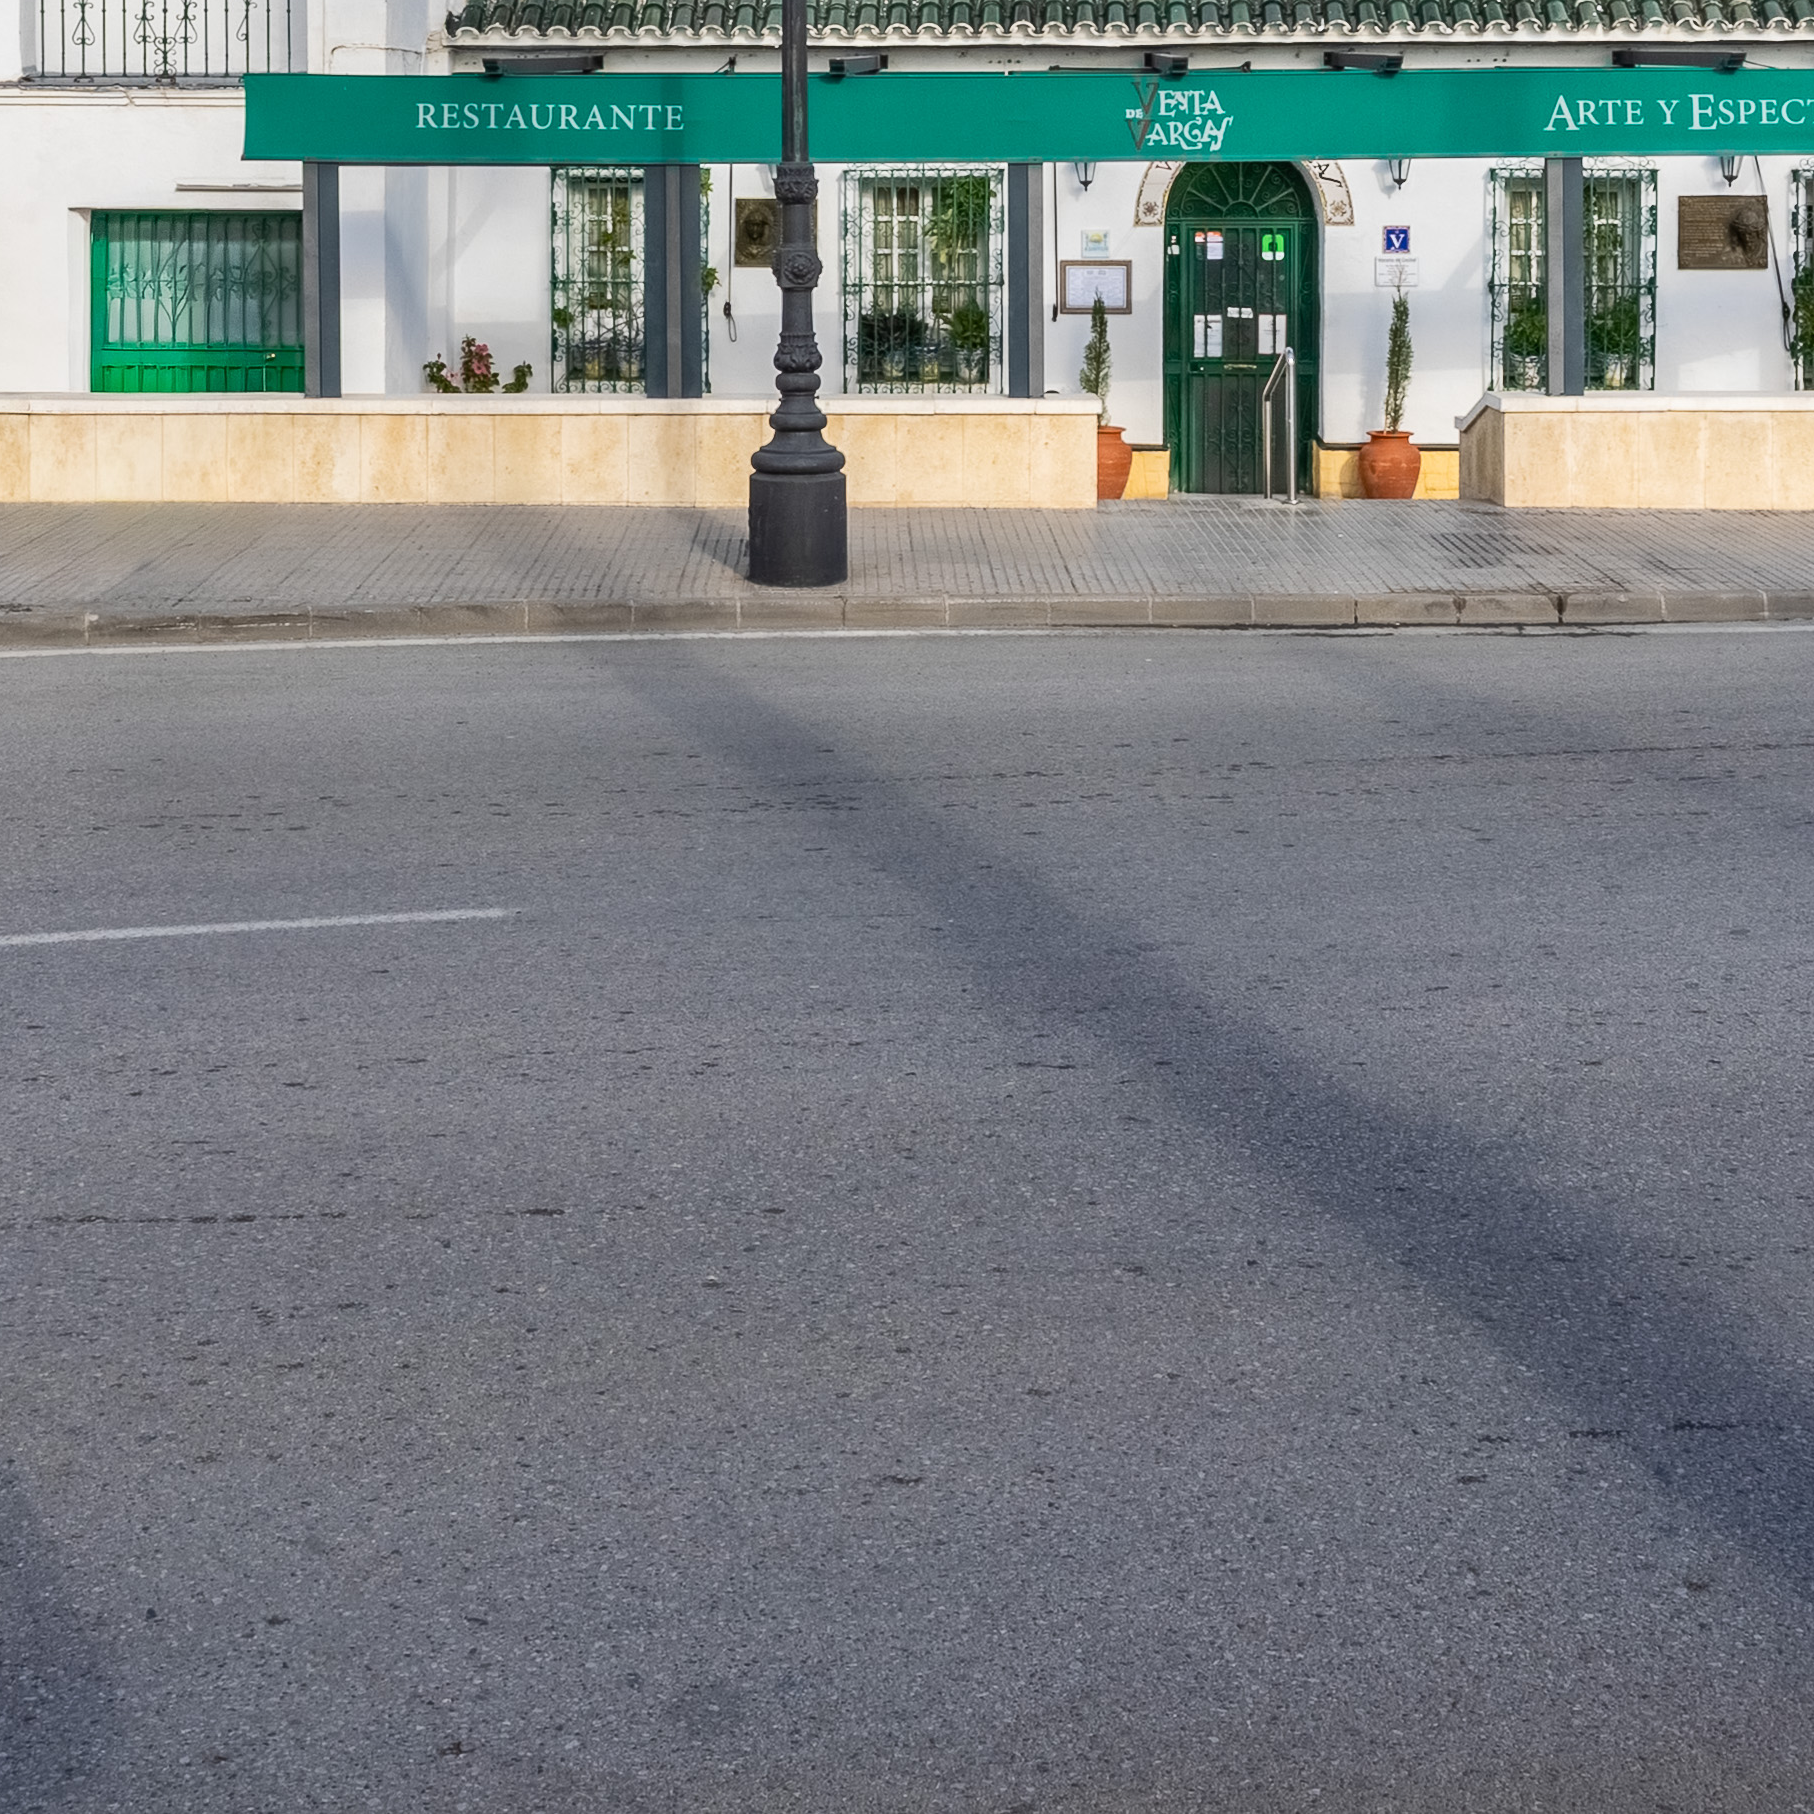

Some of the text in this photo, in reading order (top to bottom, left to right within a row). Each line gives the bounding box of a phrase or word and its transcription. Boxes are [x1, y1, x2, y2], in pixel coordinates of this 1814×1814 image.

[1125, 109, 1144, 119] DE
[1131, 82, 1226, 118] VENTA
[1657, 100, 1680, 125] Y
[415, 103, 685, 131] RESTAURANTE
[1125, 116, 1234, 152] VARGAS
